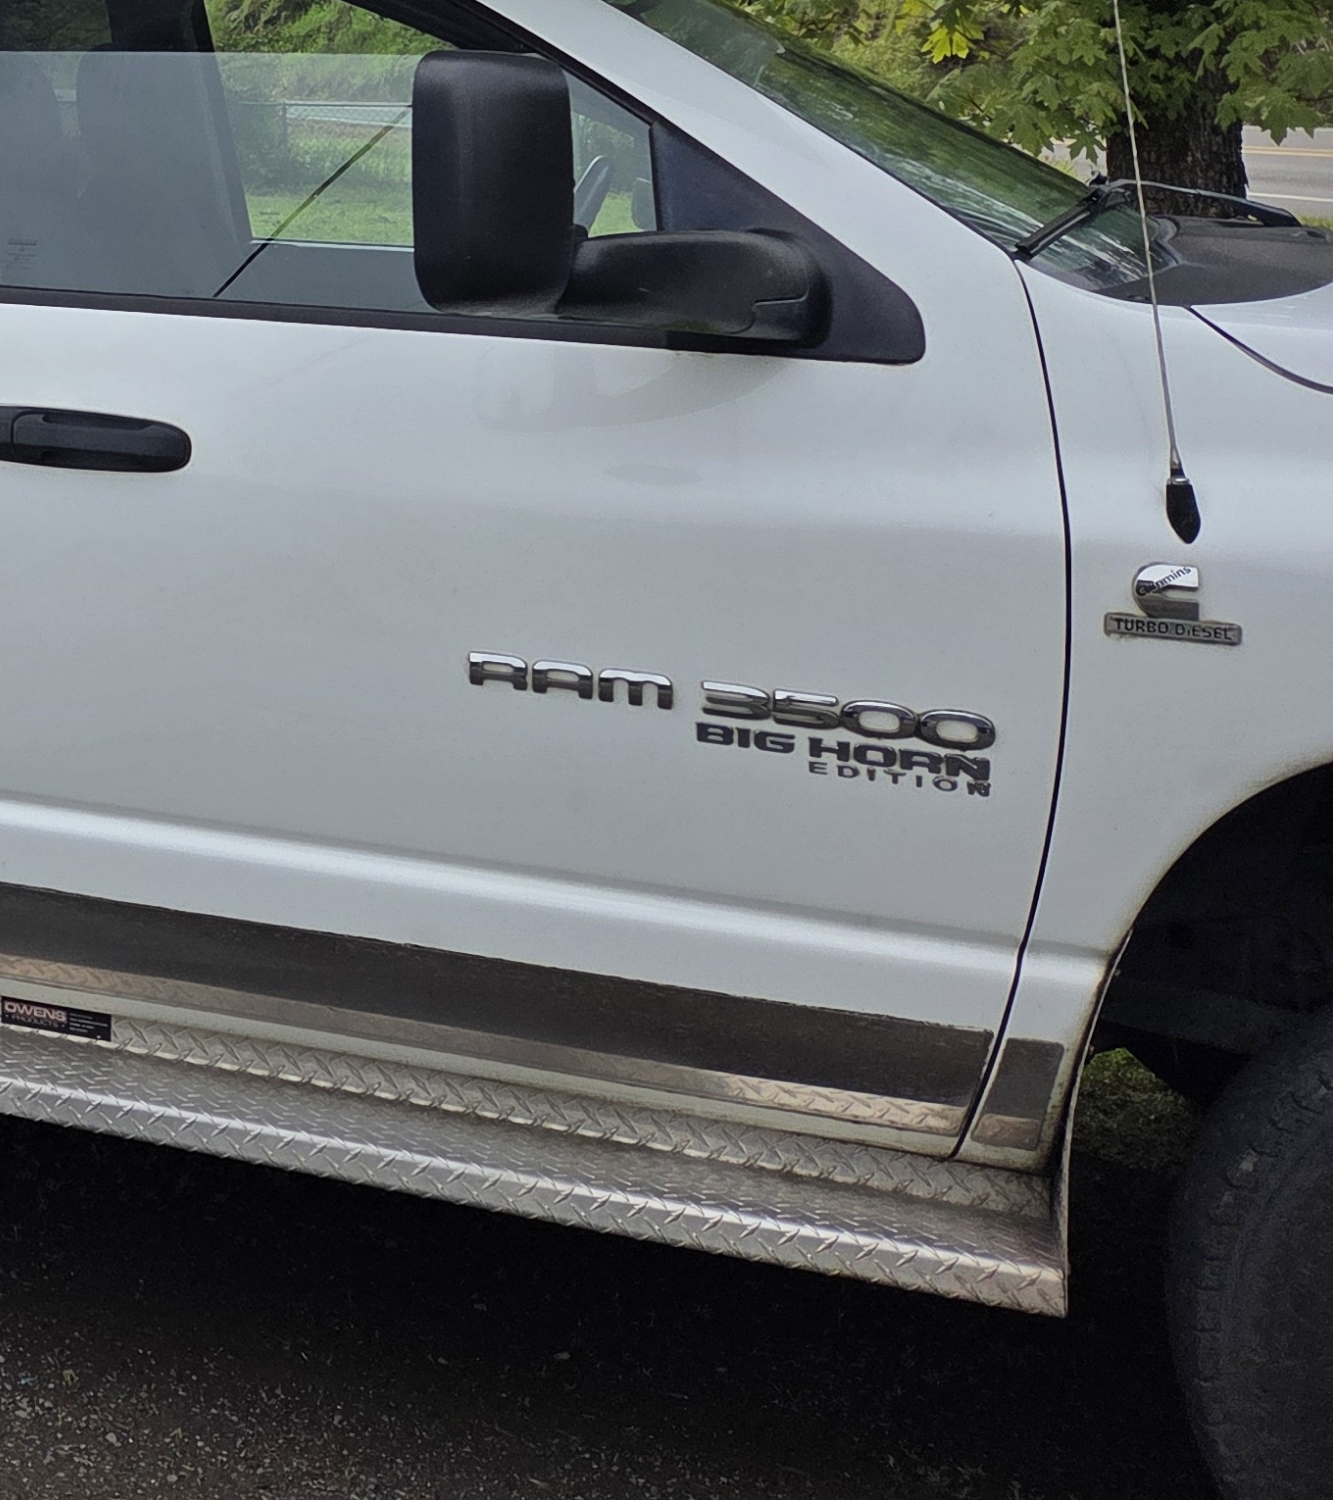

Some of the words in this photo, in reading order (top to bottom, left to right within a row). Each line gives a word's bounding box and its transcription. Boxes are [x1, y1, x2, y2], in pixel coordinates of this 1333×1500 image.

[1114, 617, 1169, 634] TURBO
[1174, 623, 1233, 641] DIESEL
[468, 650, 674, 710] RAM
[700, 680, 997, 752] 3500
[695, 721, 796, 755] BIG
[808, 736, 992, 781] HORN
[808, 760, 992, 798] EDITION
[4, 1002, 67, 1022] OWENS
